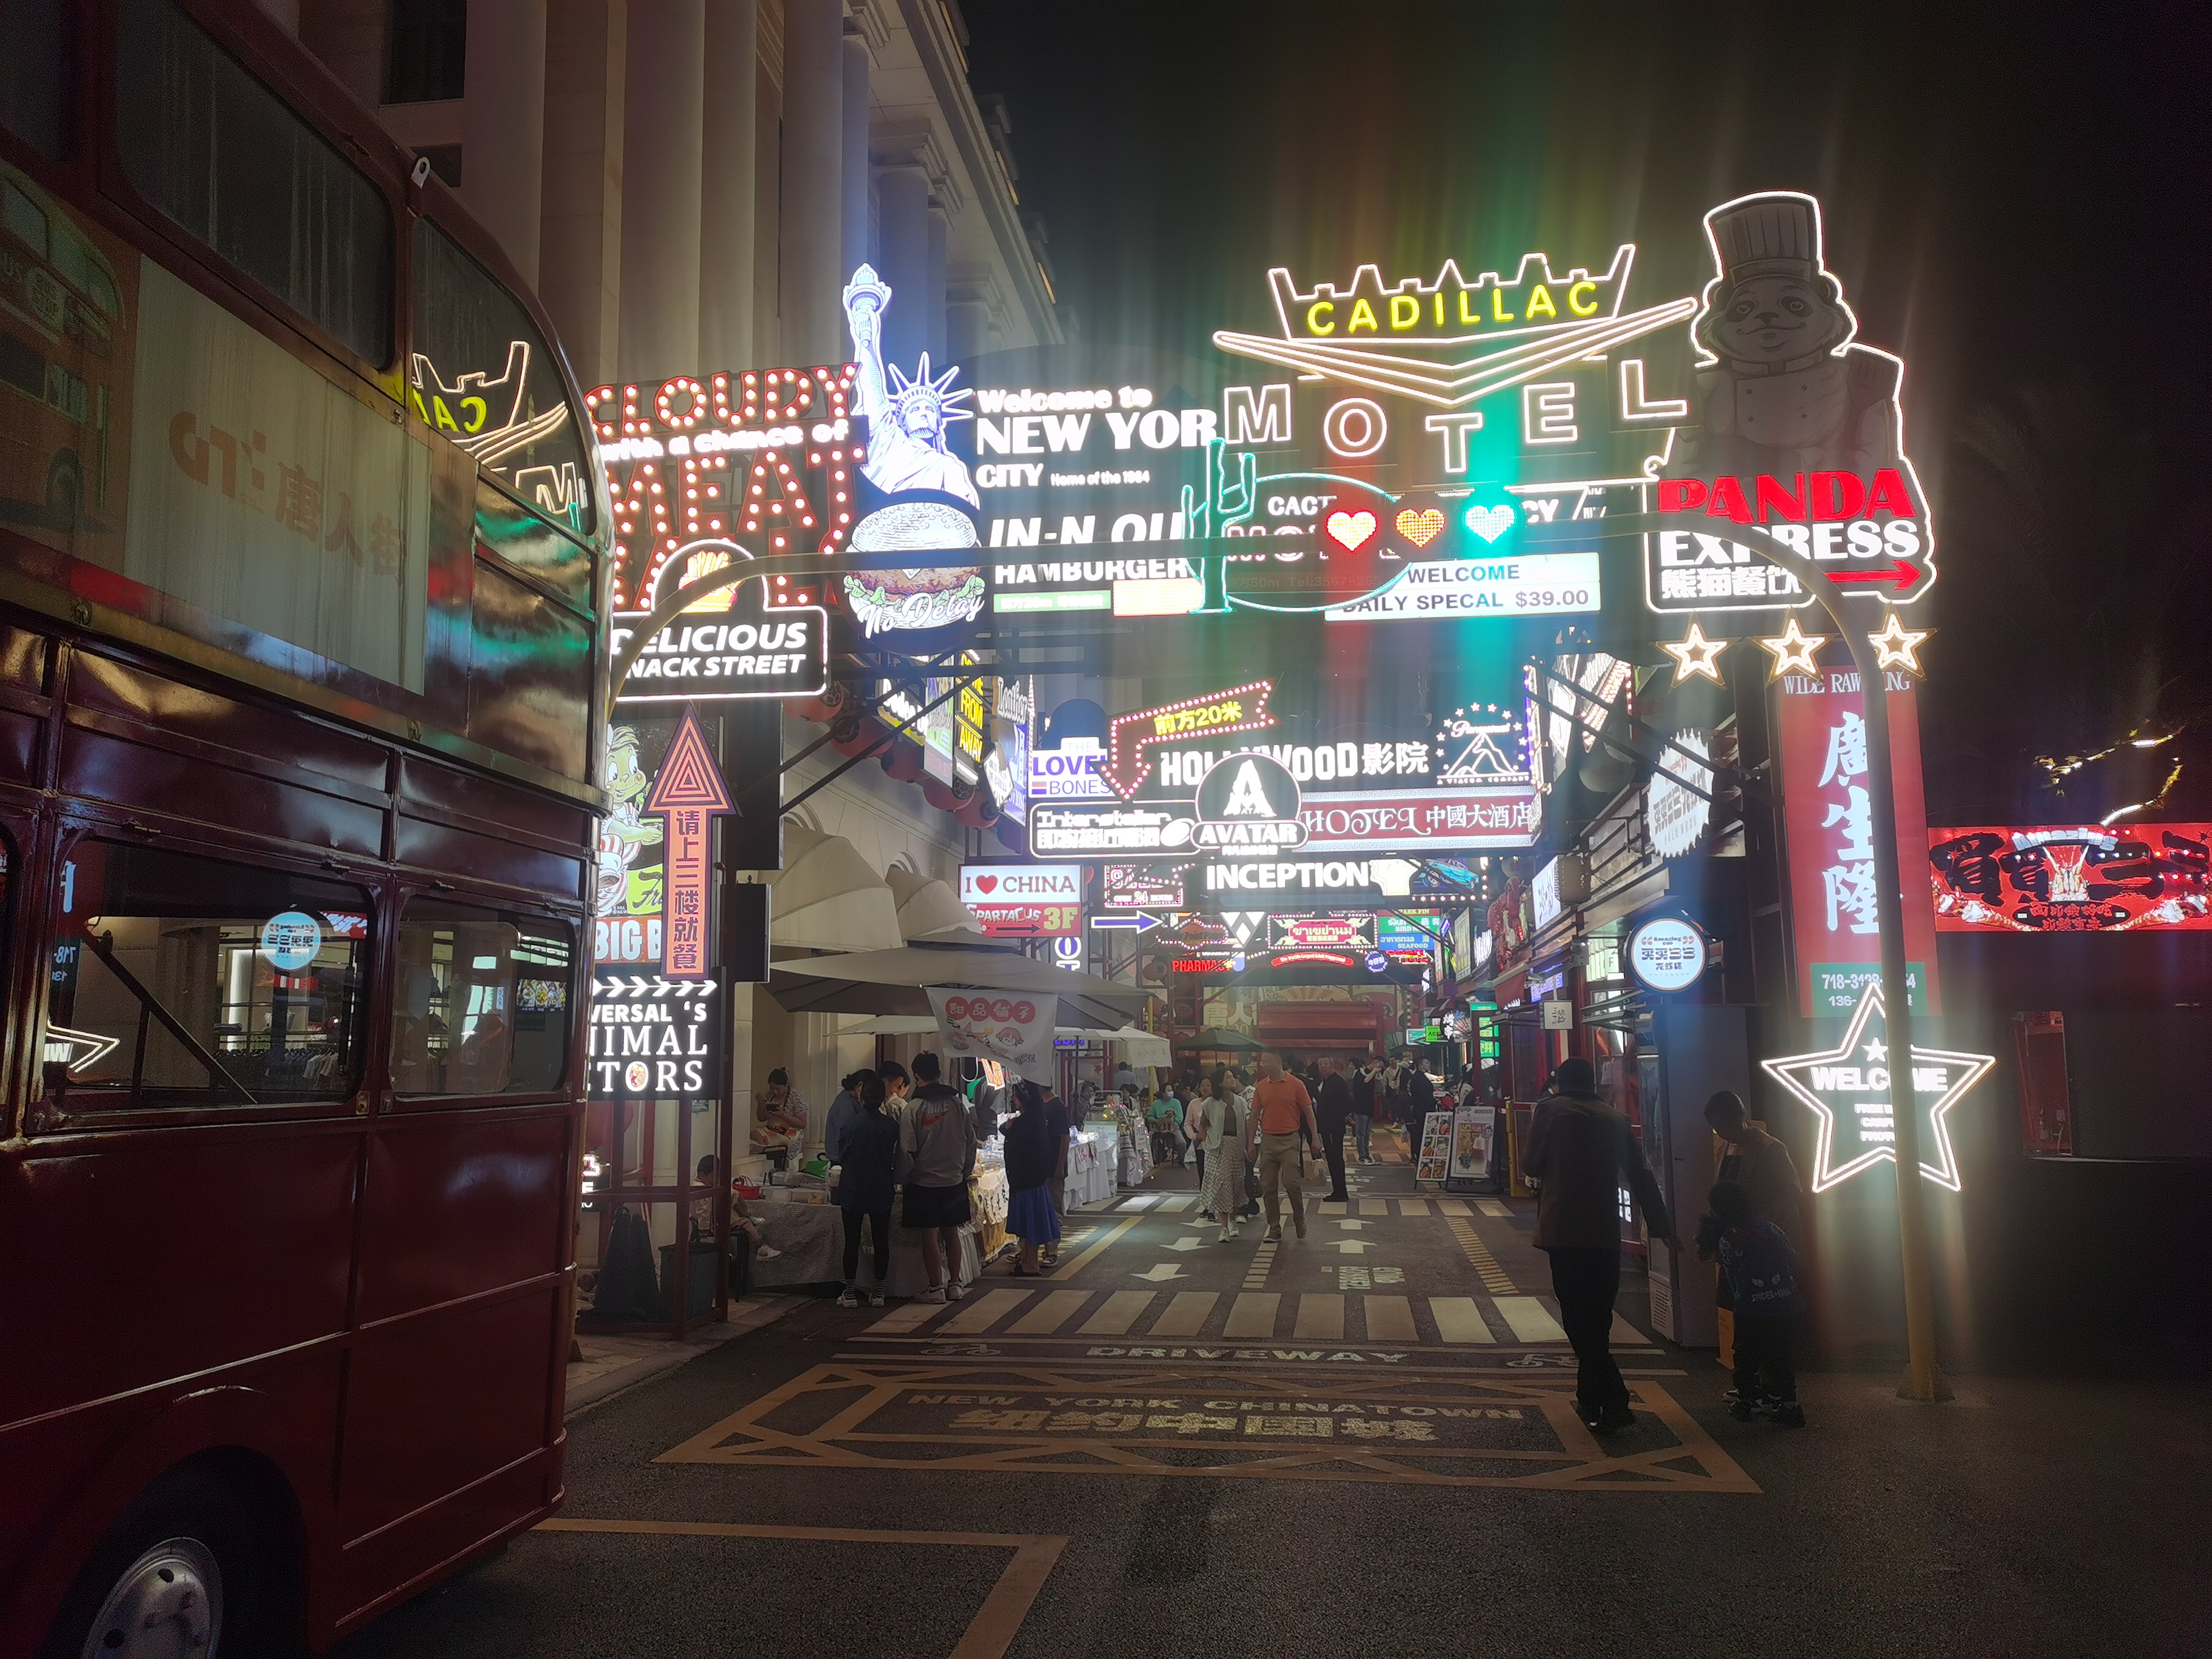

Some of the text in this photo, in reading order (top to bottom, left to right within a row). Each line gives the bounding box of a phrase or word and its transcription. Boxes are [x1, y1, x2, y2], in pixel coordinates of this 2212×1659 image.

[1307, 282, 1599, 335] CADILLAC
[977, 386, 1153, 414] Welcome to
[1224, 360, 1689, 472] MOTEL
[668, 432, 690, 455] a
[694, 424, 803, 456] chance
[813, 418, 849, 444] of
[977, 409, 1217, 454] NEW YOR
[976, 463, 1044, 488] CITY
[1658, 468, 1917, 524] PANDA
[276, 462, 400, 575] 唐人街
[994, 558, 1188, 585] HAMBURGER
[1406, 565, 1520, 585] WELCOME
[1661, 565, 1803, 599] 熊猫餐饮
[1416, 592, 1504, 610] SPECAL
[1515, 589, 1589, 609] $39.00
[859, 591, 985, 639] No Delay
[625, 654, 806, 679] NACK STREET
[1153, 700, 1242, 736] 前方20米
[960, 725, 984, 763] AWAY
[1362, 741, 1430, 776] 影院
[1049, 780, 1112, 796] BONES
[1301, 806, 1432, 836] HOTEL
[1426, 802, 1532, 830] 中國大酒店
[1199, 823, 1298, 844] AVATAR
[673, 810, 700, 969] 请上三楼就餐
[965, 875, 1076, 893] I CHINA
[1207, 862, 1369, 890] INCEPTION
[1134, 891, 1148, 902] 24
[1044, 907, 1079, 930] 3F
[594, 919, 643, 962] BIG
[587, 1061, 703, 1092] TORS
[927, 1101, 949, 1114] NIKE
[1086, 1346, 1410, 1365] DRIVEWAY
[907, 1395, 1525, 1419] NEW YORK CHINATOWN
[948, 1409, 1441, 1443] 纽约中国城
